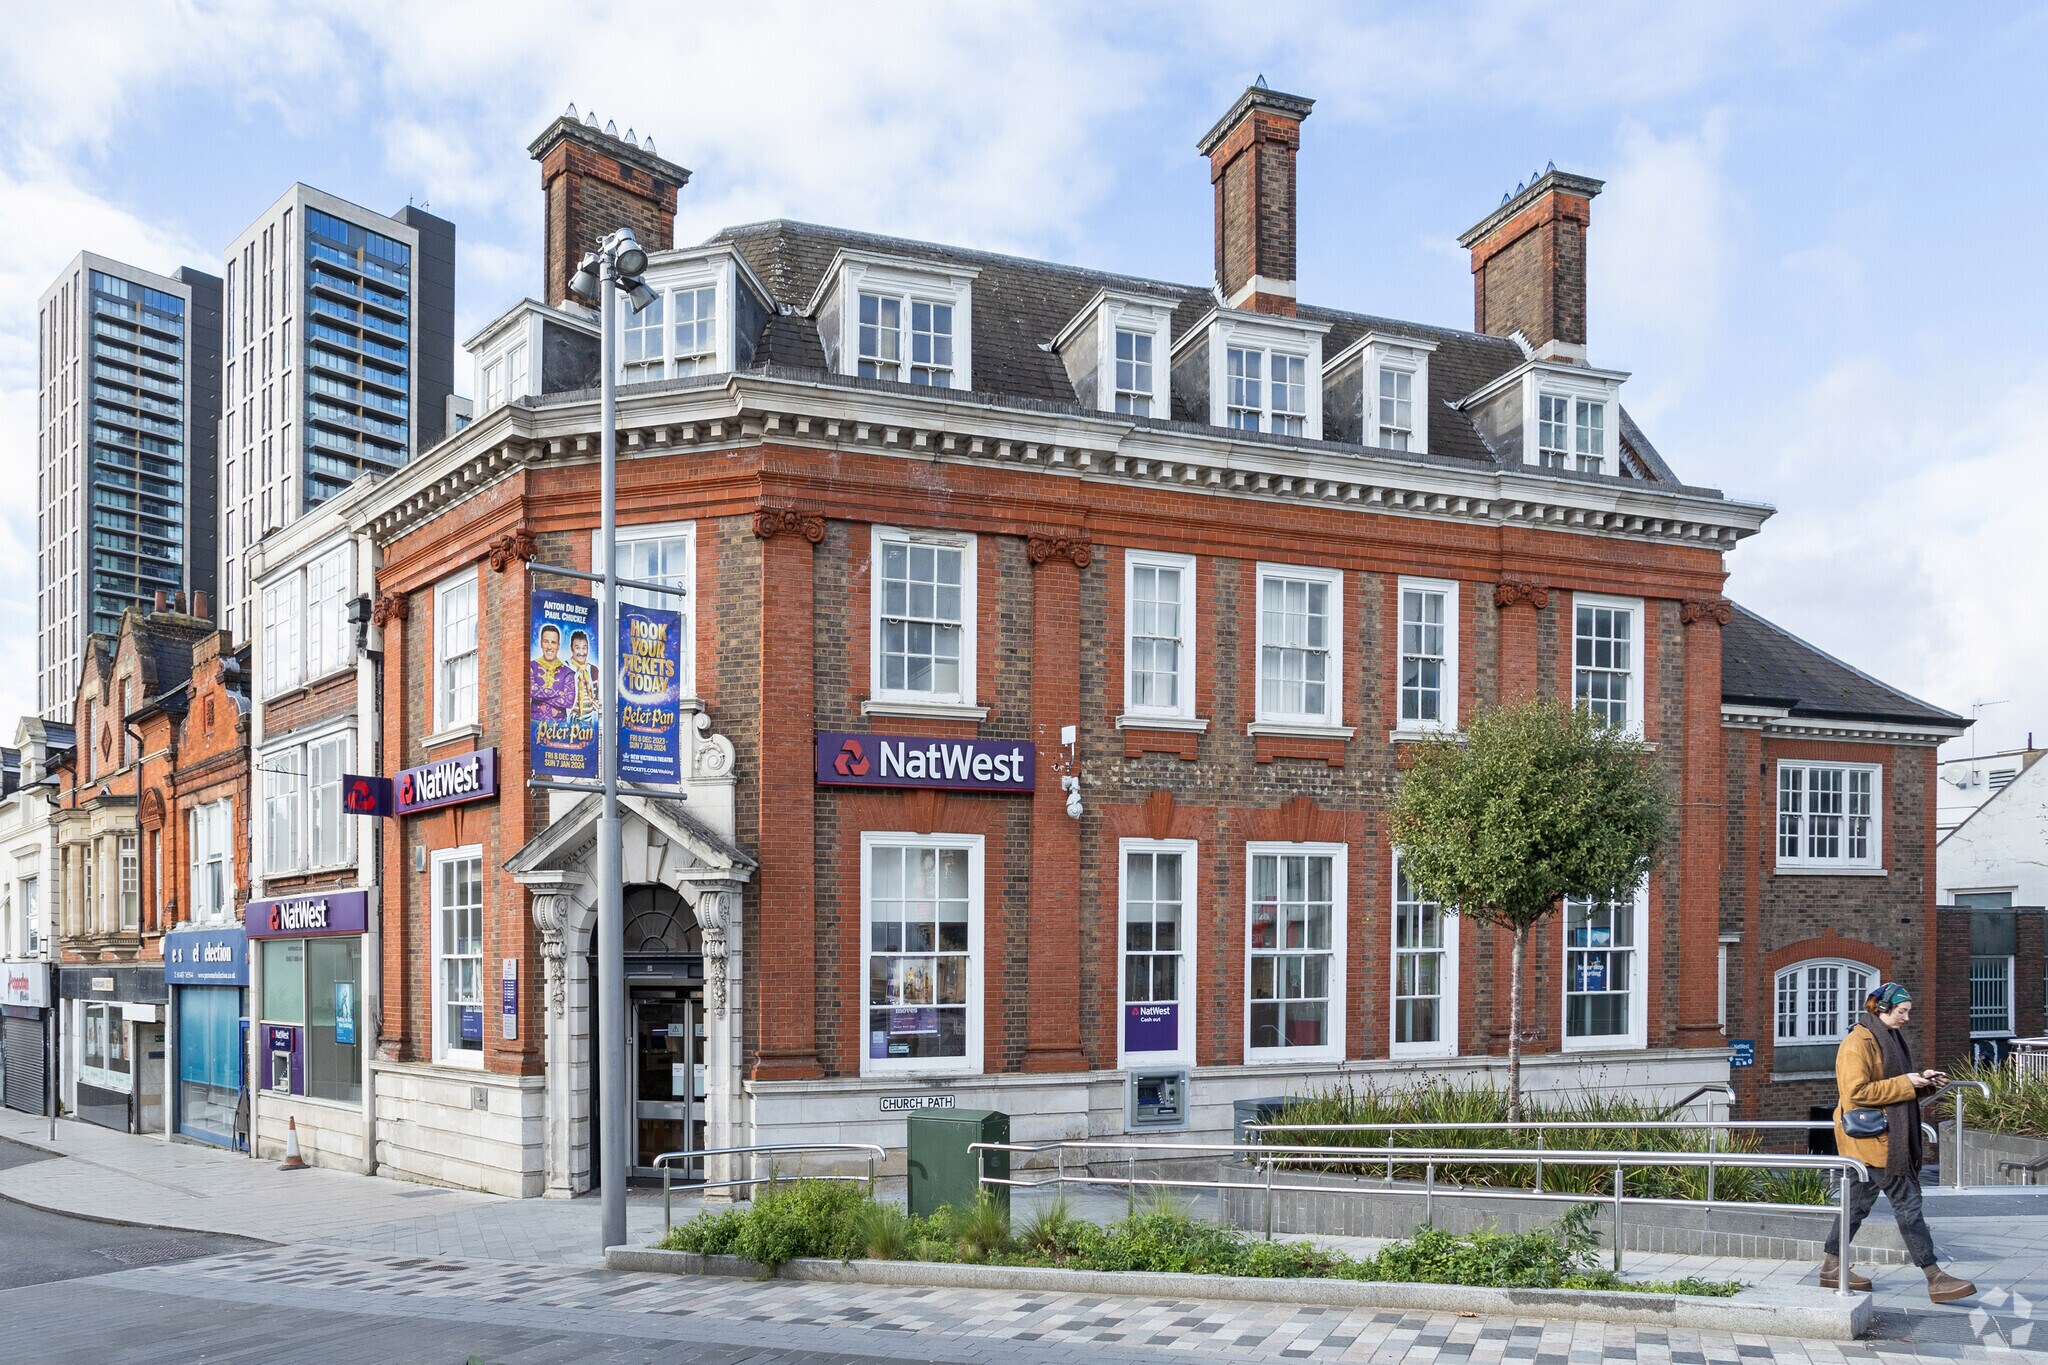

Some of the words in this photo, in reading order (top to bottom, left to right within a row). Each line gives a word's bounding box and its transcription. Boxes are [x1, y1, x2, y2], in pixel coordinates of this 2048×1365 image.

[543, 600, 565, 612] ANTON
[565, 603, 575, 613] DU
[575, 605, 588, 615] BEKE
[544, 610, 561, 620] PAUL
[561, 612, 586, 624] CHUCKLE
[630, 619, 668, 641] HOOK
[631, 637, 666, 659] YOUR
[623, 653, 675, 677] TICKETS
[628, 671, 670, 694] TODAY
[621, 705, 652, 728] Peter
[651, 708, 674, 729] Pan
[536, 721, 569, 745] Peter
[569, 723, 594, 745] Pan
[630, 734, 638, 742] FRI
[642, 735, 653, 744] DEC
[653, 736, 666, 745] 2023
[545, 751, 554, 760] FRI
[554, 752, 559, 760] 8
[559, 752, 570, 761] DEC
[570, 754, 584, 762] 2023
[629, 741, 640, 749] SUN
[643, 742, 653, 750] JAN
[653, 744, 667, 752] 2024
[544, 758, 556, 767] SUN
[560, 760, 571, 768] JAN
[571, 761, 585, 769] 2024
[880, 741, 1024, 783] NatWest
[416, 756, 479, 802] NatWest
[281, 899, 327, 930] NatWest
[204, 941, 232, 962] election
[1140, 1006, 1171, 1016] NatWest
[275, 1030, 290, 1040] NatWest
[882, 1098, 922, 1109] CHURCH
[928, 1097, 952, 1108] PATH
